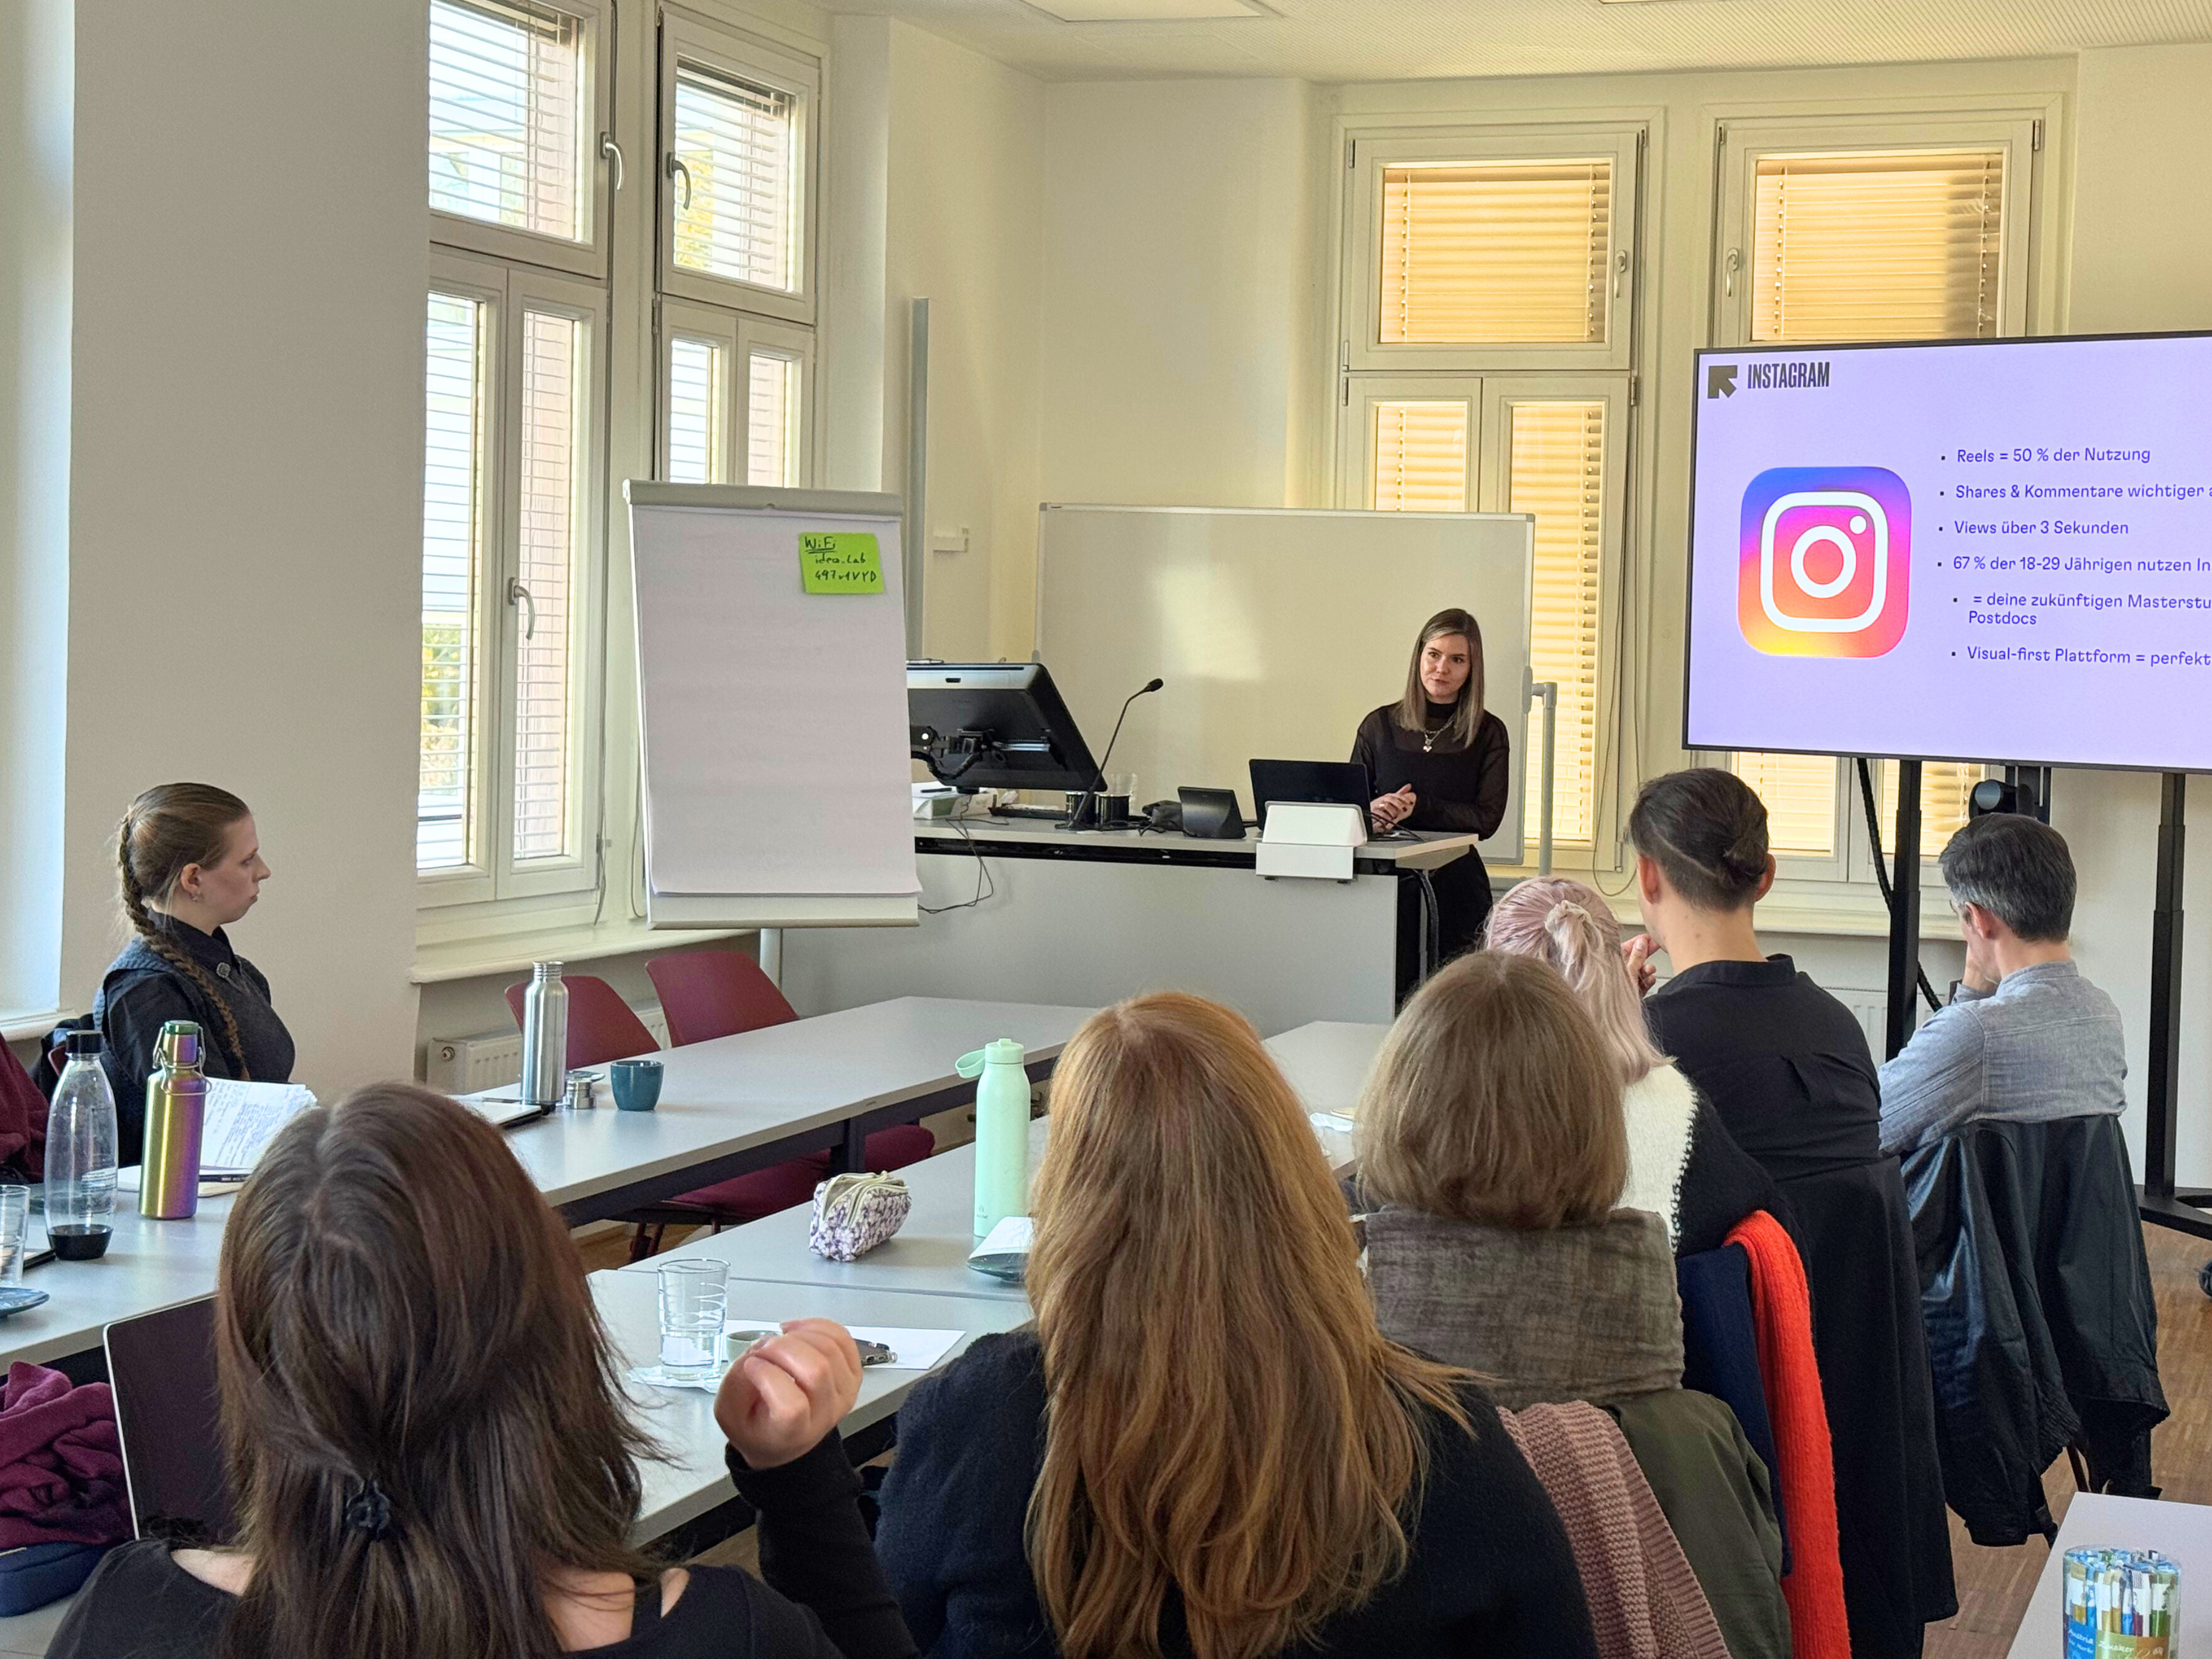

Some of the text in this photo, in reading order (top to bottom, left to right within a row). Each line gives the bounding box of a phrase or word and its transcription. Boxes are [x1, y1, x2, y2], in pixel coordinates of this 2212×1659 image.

[1747, 362, 1830, 389] INSTAGRAM
[1957, 449, 1995, 462] Reels
[2013, 448, 2032, 462] 50
[2036, 448, 2049, 461] %
[2053, 448, 2080, 461] der
[2085, 447, 2151, 464] Nutzung
[1956, 484, 2006, 499] Shares
[2011, 484, 2020, 498] &
[2025, 484, 2123, 498] Kommentare
[2128, 483, 2204, 500] wichtiger
[1954, 520, 2129, 534] Views über 3 Sekunden
[1953, 556, 2212, 574] 67 % der 18-29 Jährigen nutzen In
[1987, 592, 2027, 606] deine
[2031, 593, 2122, 611] zukünftigen
[2128, 594, 2211, 609] Masterstu
[1968, 610, 2037, 625] Postdocs
[1967, 646, 2050, 662] Visual-first
[2055, 648, 2130, 663] Plattform
[2151, 651, 2211, 667] perfekt
